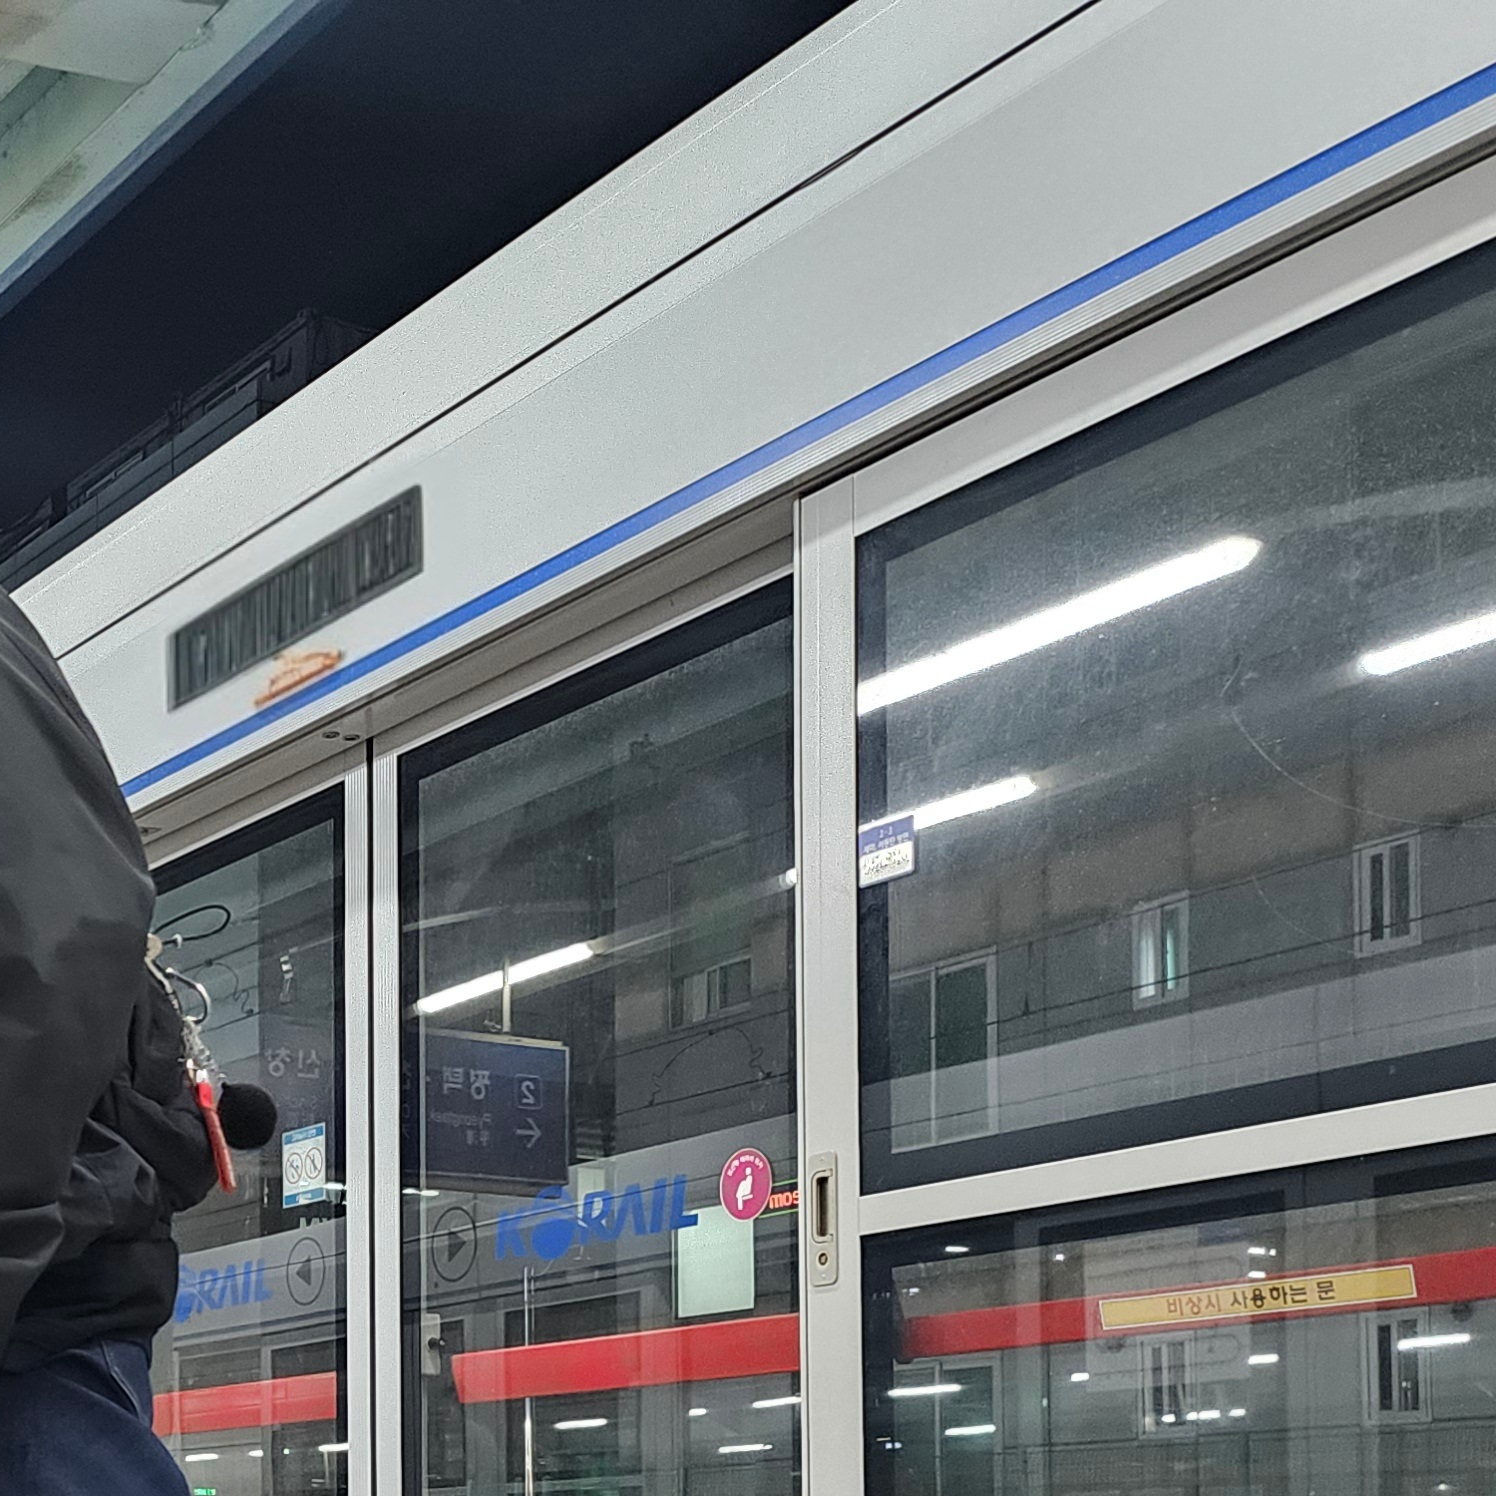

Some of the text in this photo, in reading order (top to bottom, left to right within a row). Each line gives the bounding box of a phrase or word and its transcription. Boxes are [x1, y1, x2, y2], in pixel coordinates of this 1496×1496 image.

[495, 1174, 699, 1261] KORAIL
[176, 1258, 273, 1324] ORAIL
[1167, 1280, 1336, 1316] 비상시 사용하는 문
